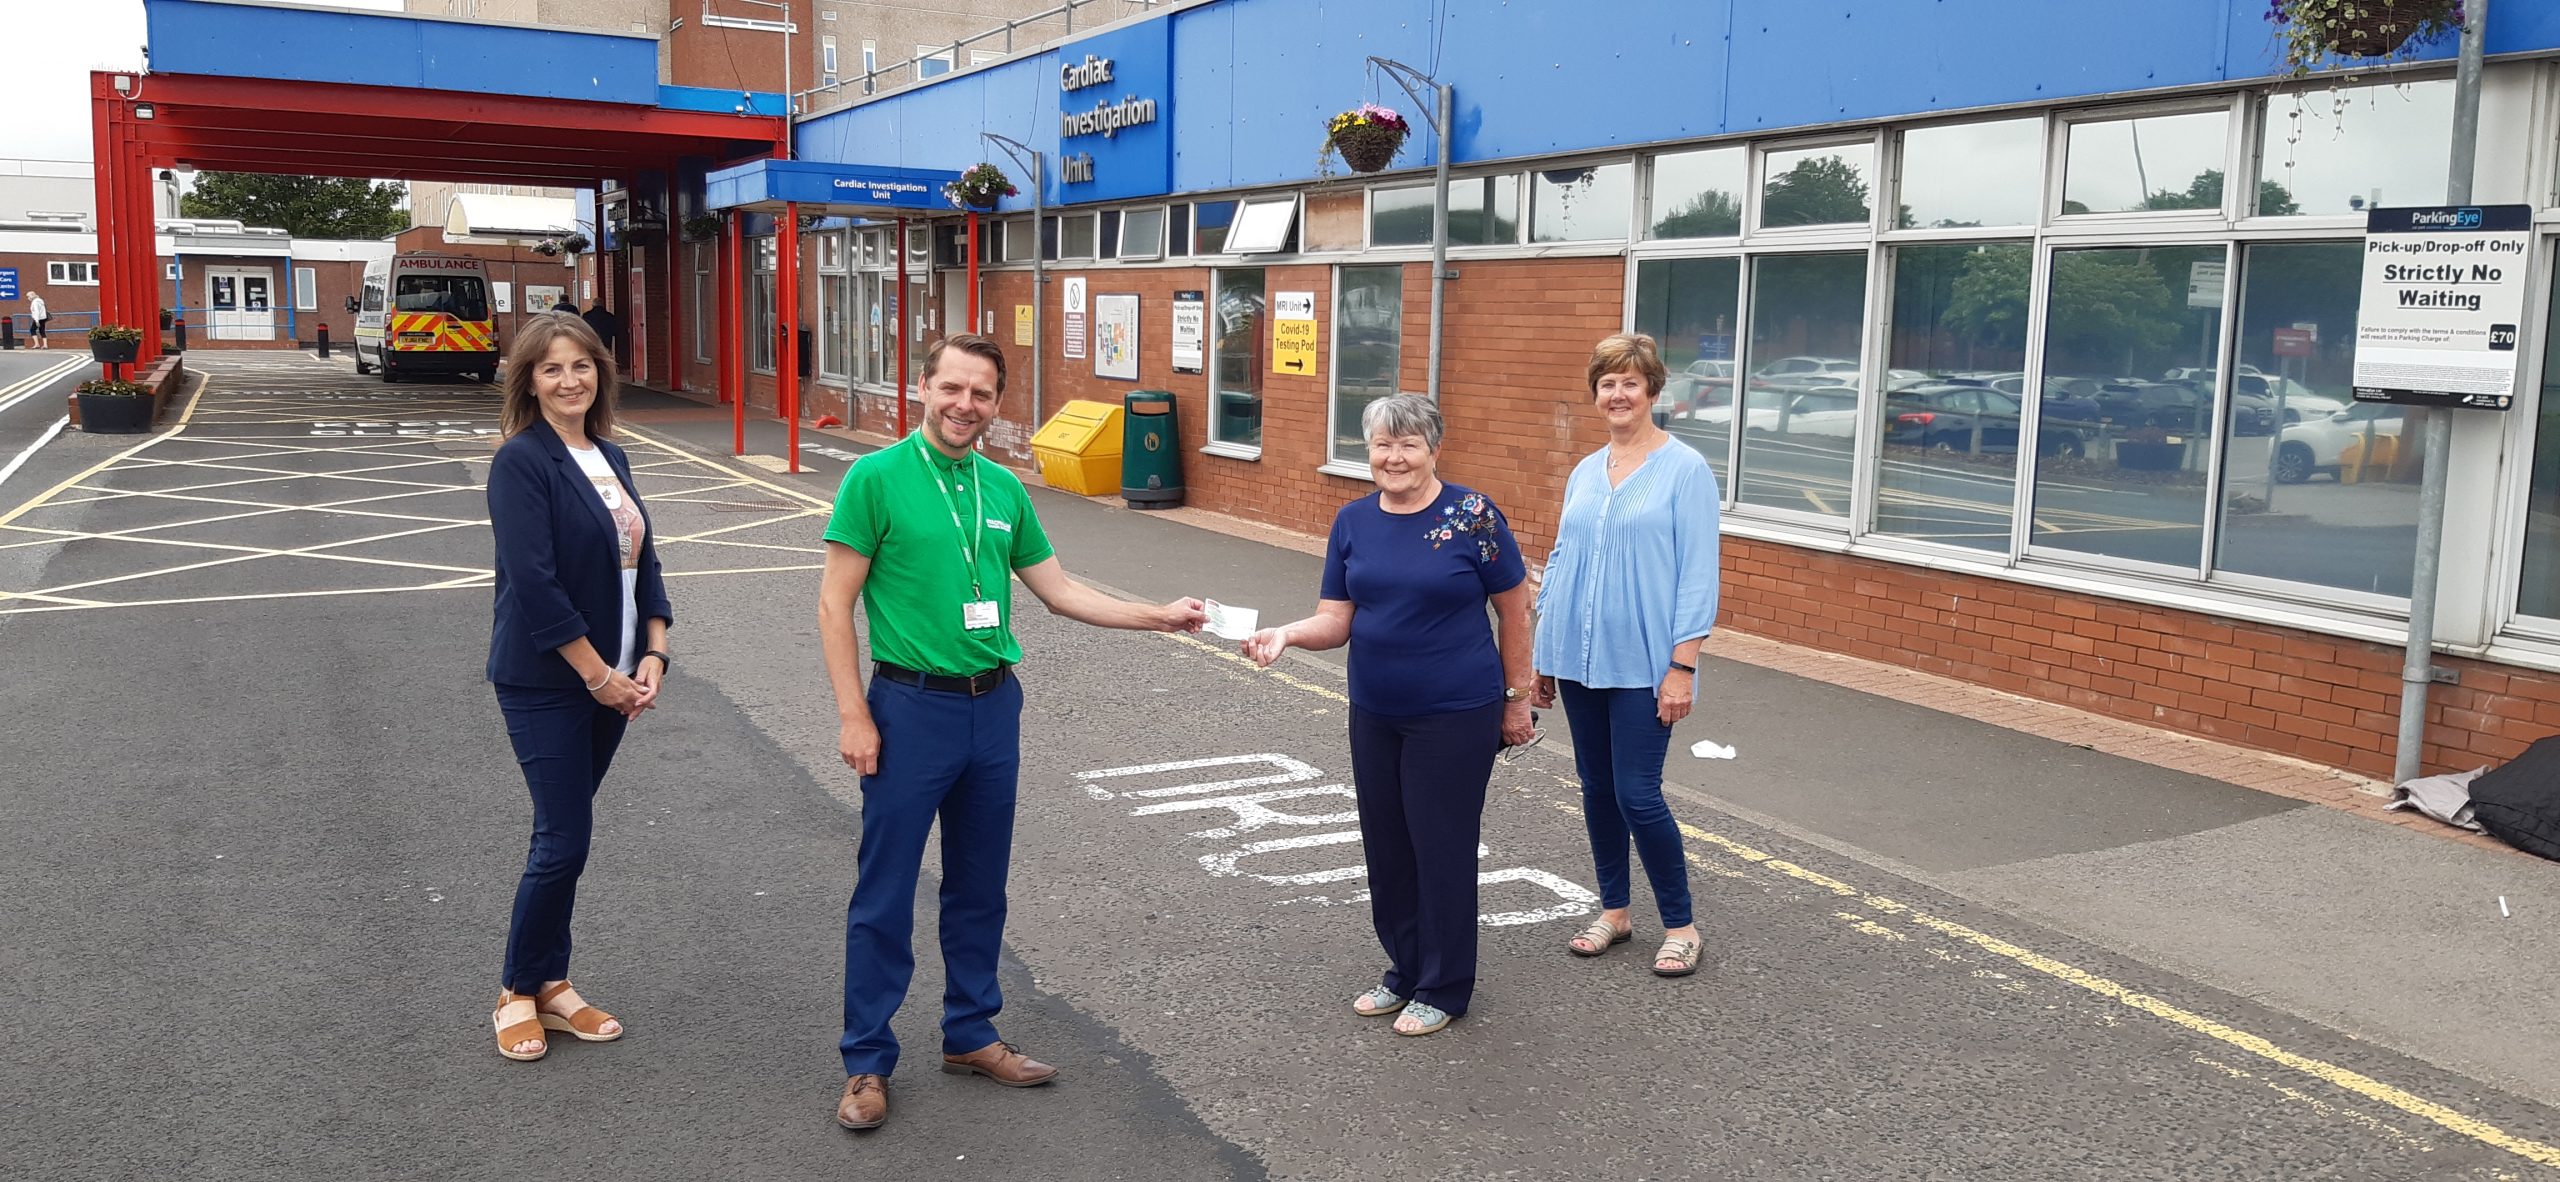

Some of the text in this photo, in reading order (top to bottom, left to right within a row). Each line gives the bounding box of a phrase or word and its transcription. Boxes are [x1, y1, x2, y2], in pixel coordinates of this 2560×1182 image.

[1060, 54, 1112, 92] Cardiac
[1060, 94, 1156, 138] Investigation
[1060, 152, 1093, 184] Unit
[834, 179, 927, 193] Cardiac Investigations
[872, 190, 891, 199] Unit
[2412, 211, 2479, 226] ParkingEye
[2369, 240, 2525, 255] Pick-up/Drop-off Only
[399, 259, 479, 270] AMBULANCE
[2384, 264, 2502, 285] Strictly No
[1276, 301, 1302, 312] MRI Unit
[2398, 290, 2482, 311] Waiting
[1280, 322, 1310, 336] Covid-19
[2490, 331, 2515, 344] £70
[1275, 339, 1315, 353] Testing Pod
